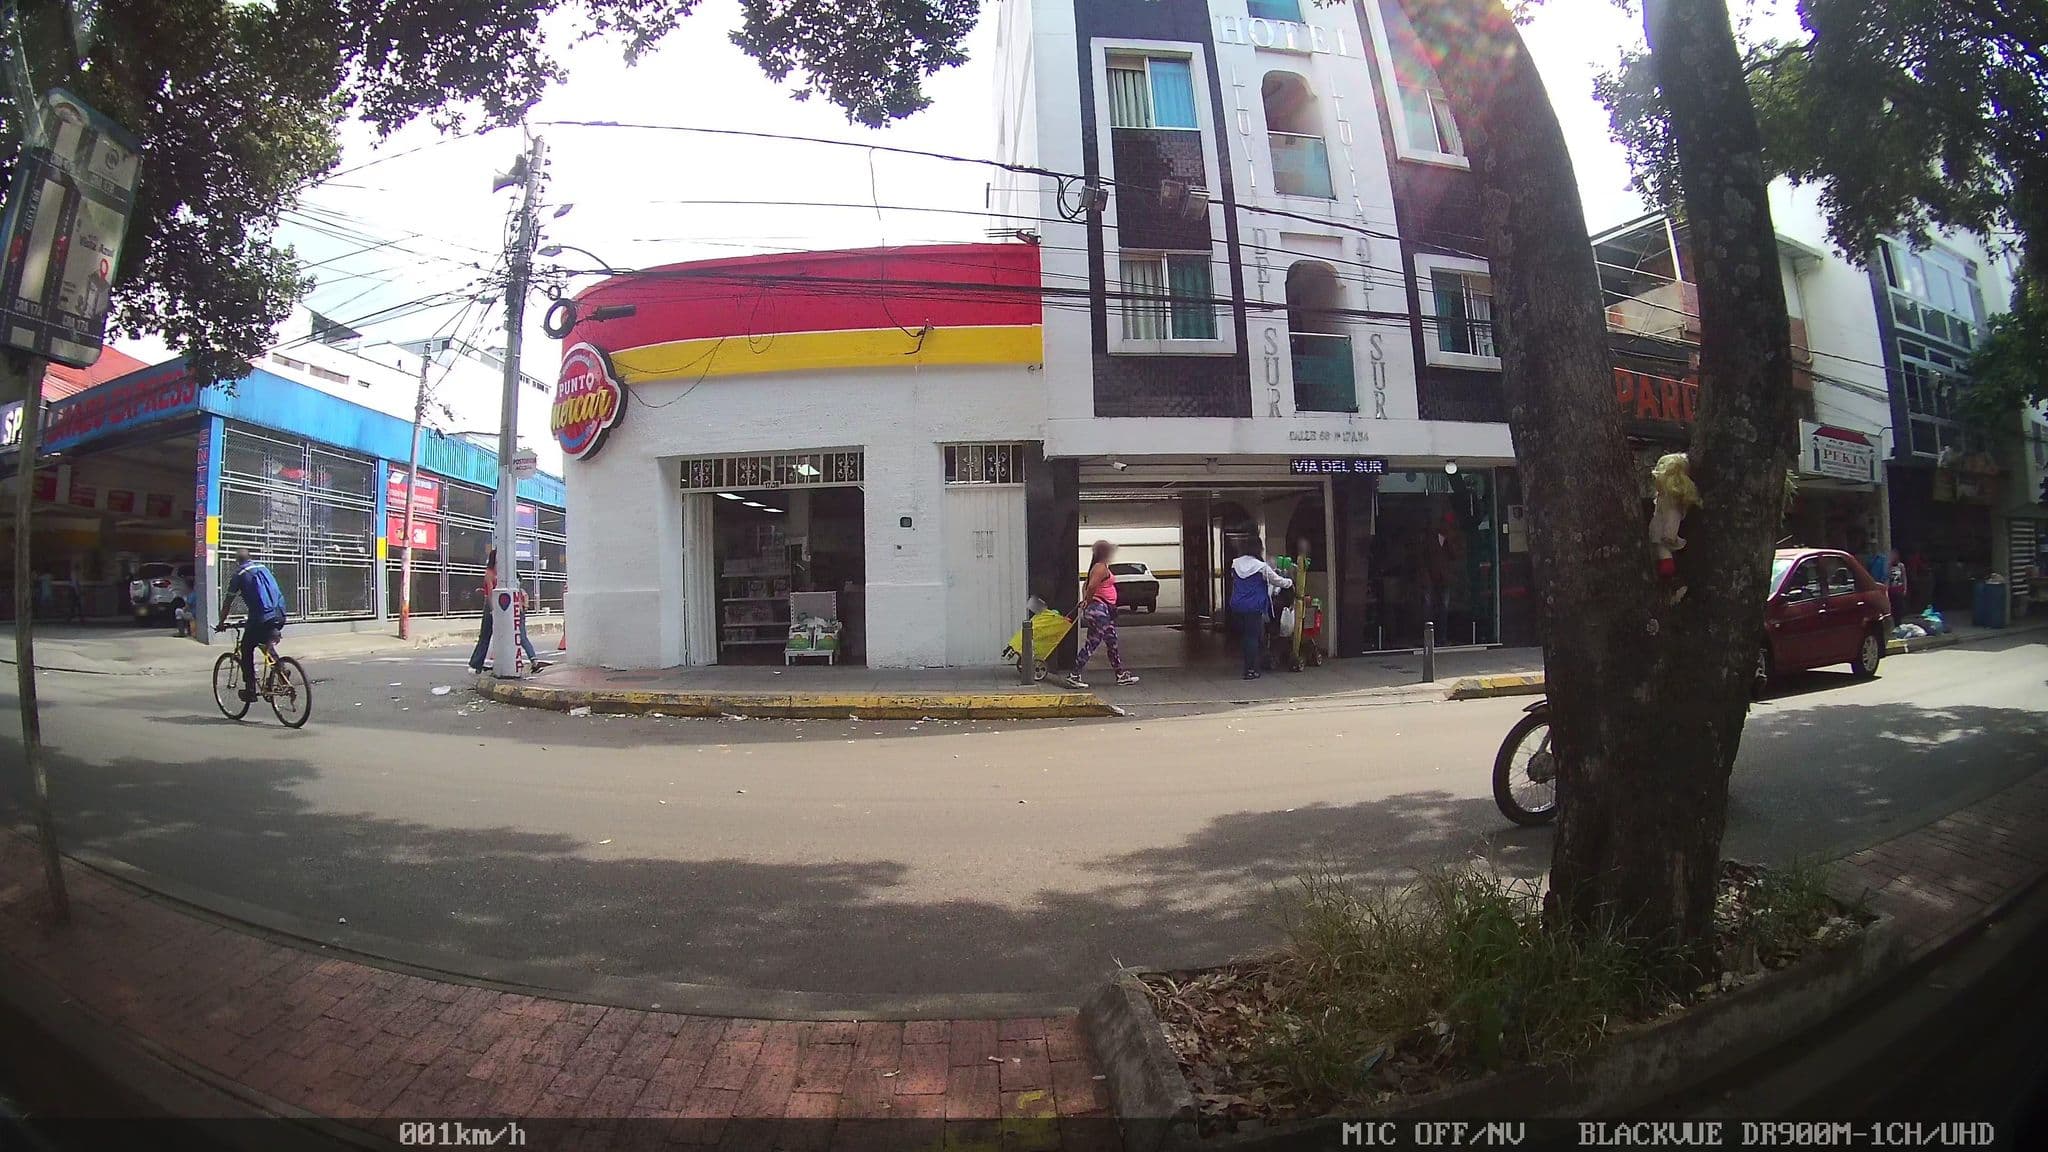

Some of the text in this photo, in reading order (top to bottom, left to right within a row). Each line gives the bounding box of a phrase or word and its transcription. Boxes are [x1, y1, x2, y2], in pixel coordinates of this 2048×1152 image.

[1217, 16, 1360, 59] HOTEL
[1329, 72, 1369, 224] LLUVIA
[1370, 333, 1388, 420] SUR
[560, 373, 595, 397] PUNTO
[1264, 327, 1282, 418] SUR
[1321, 459, 1351, 473] DEL
[1354, 459, 1382, 474] SUR
[1823, 448, 1867, 465] PEKIN
[513, 591, 525, 673] MERCAR
